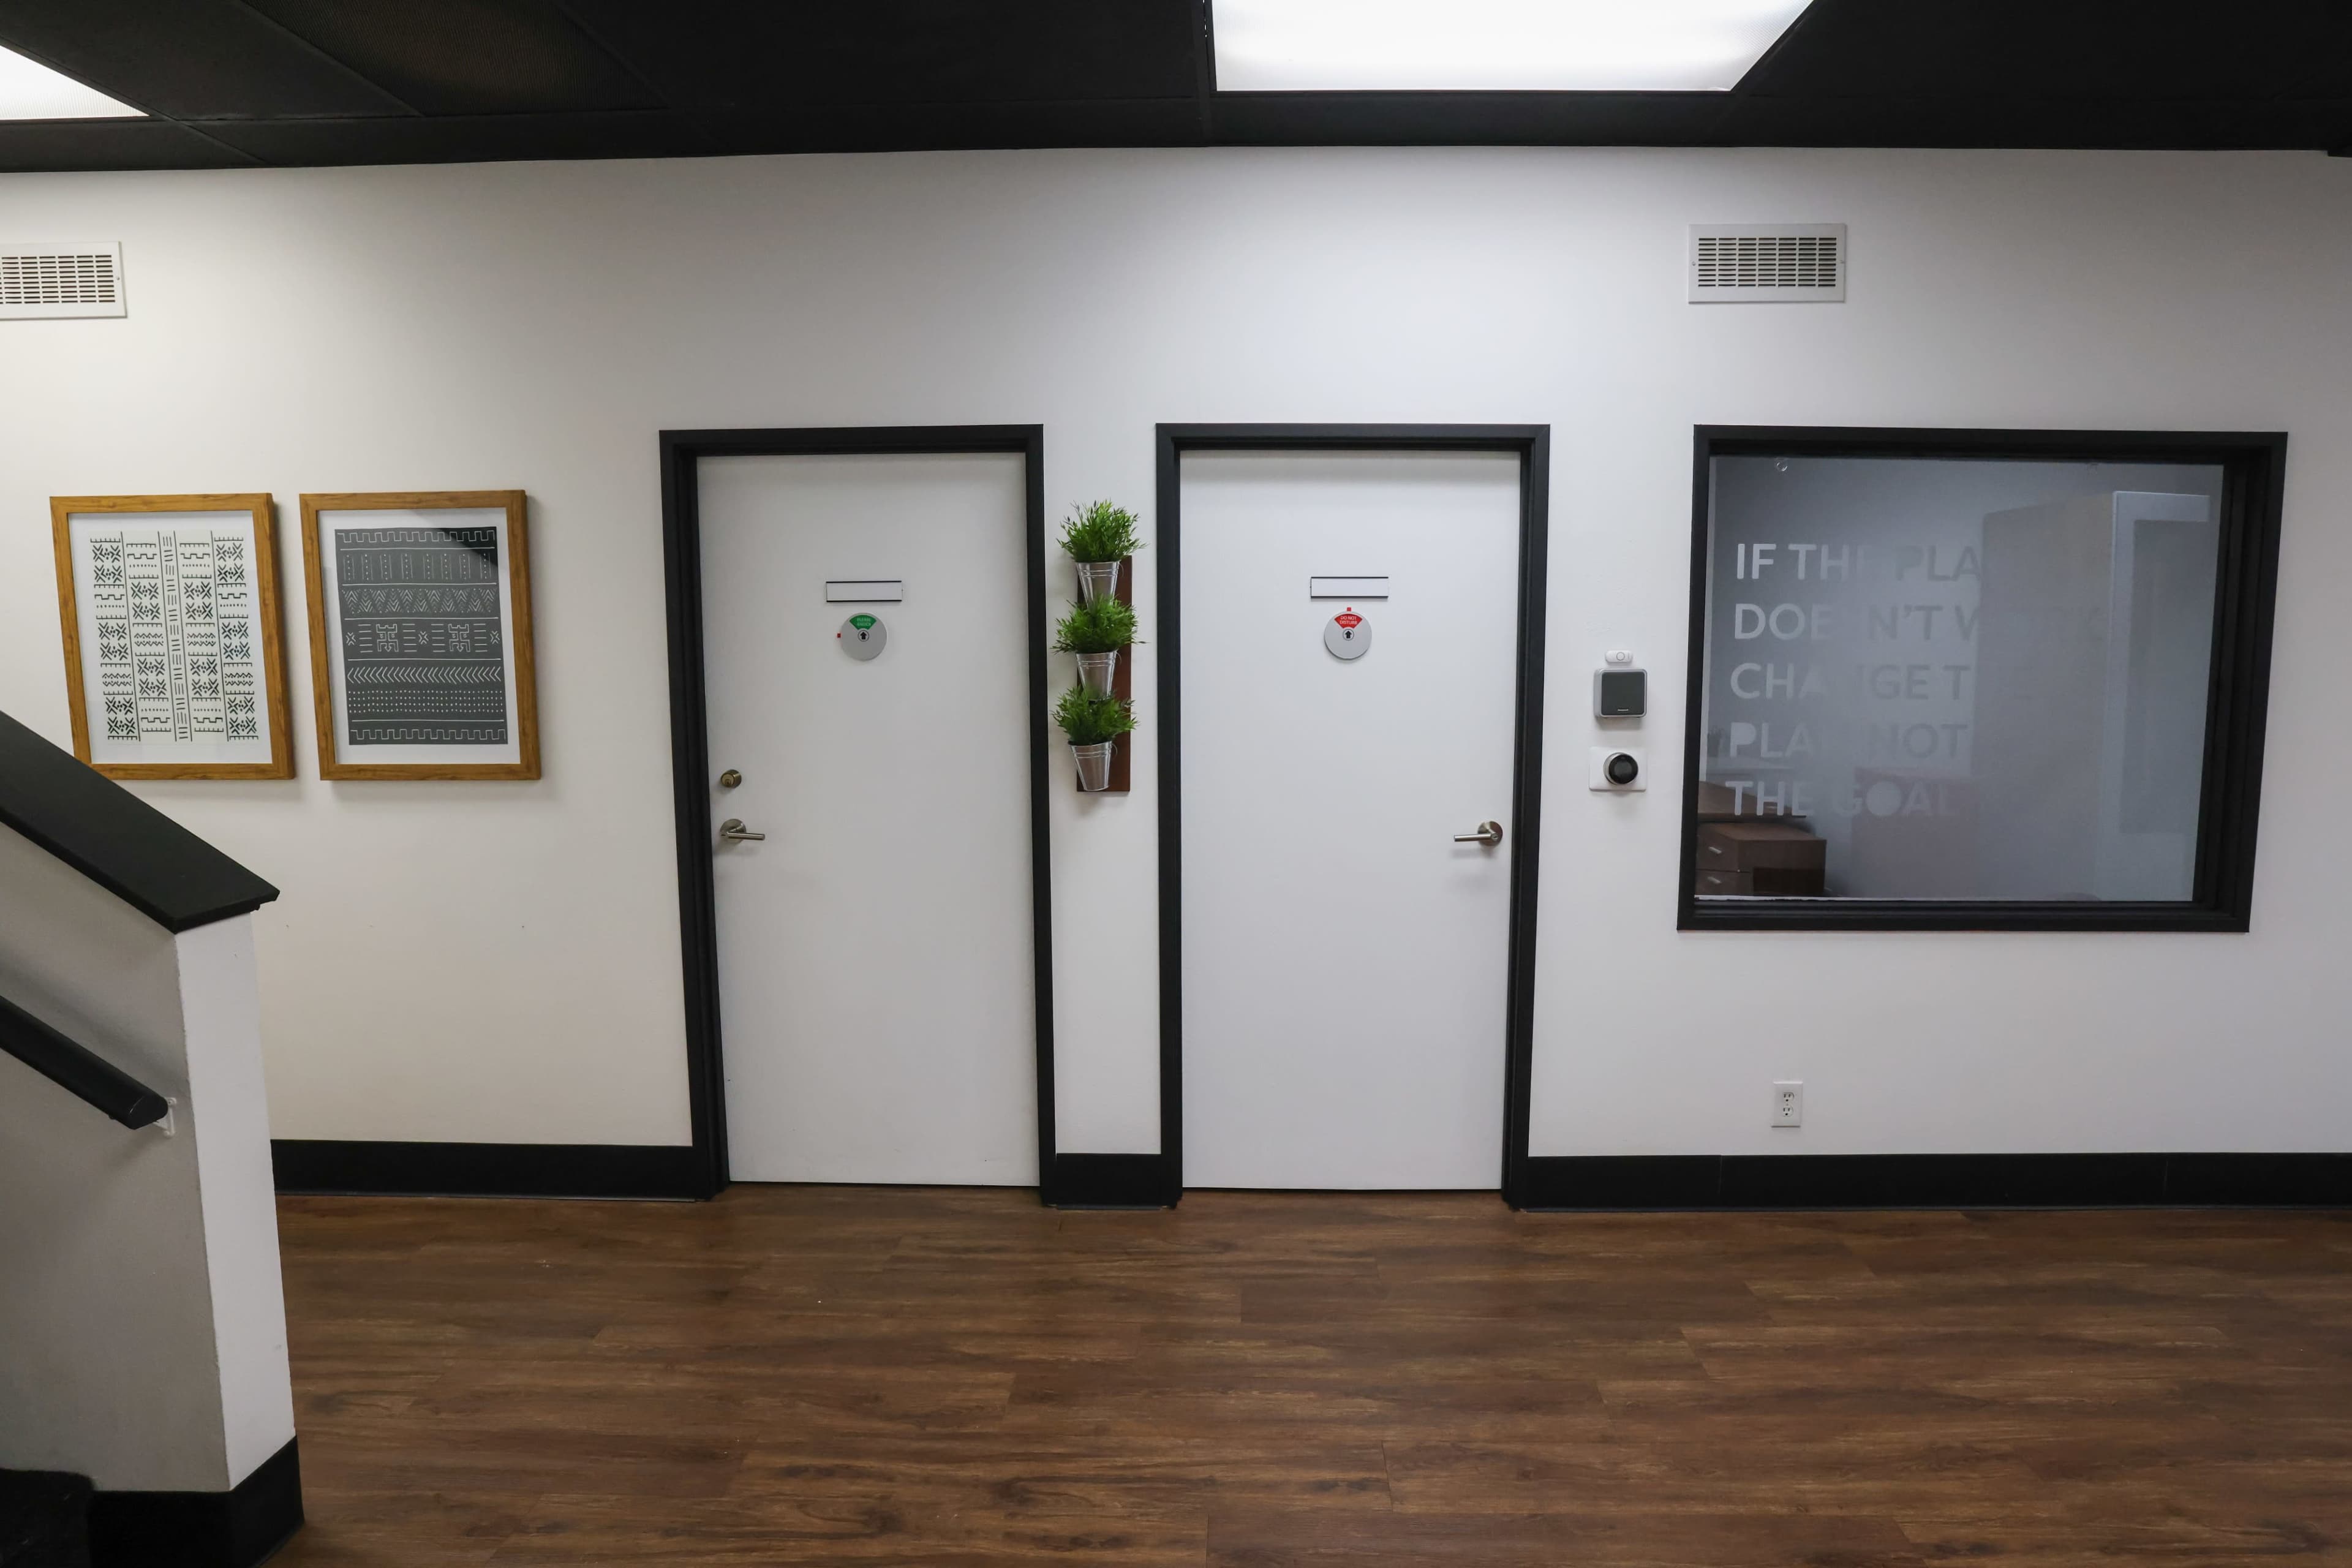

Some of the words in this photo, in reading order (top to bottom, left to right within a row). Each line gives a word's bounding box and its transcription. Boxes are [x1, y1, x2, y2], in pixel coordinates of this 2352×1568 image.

[1735, 543, 1777, 580] IF
[1895, 545, 1986, 581] PLA
[1734, 603, 1943, 641] DOEN'T
[1730, 663, 1931, 701] CHAGE
[1728, 722, 1831, 759] PLA
[1725, 781, 1814, 816] THE
